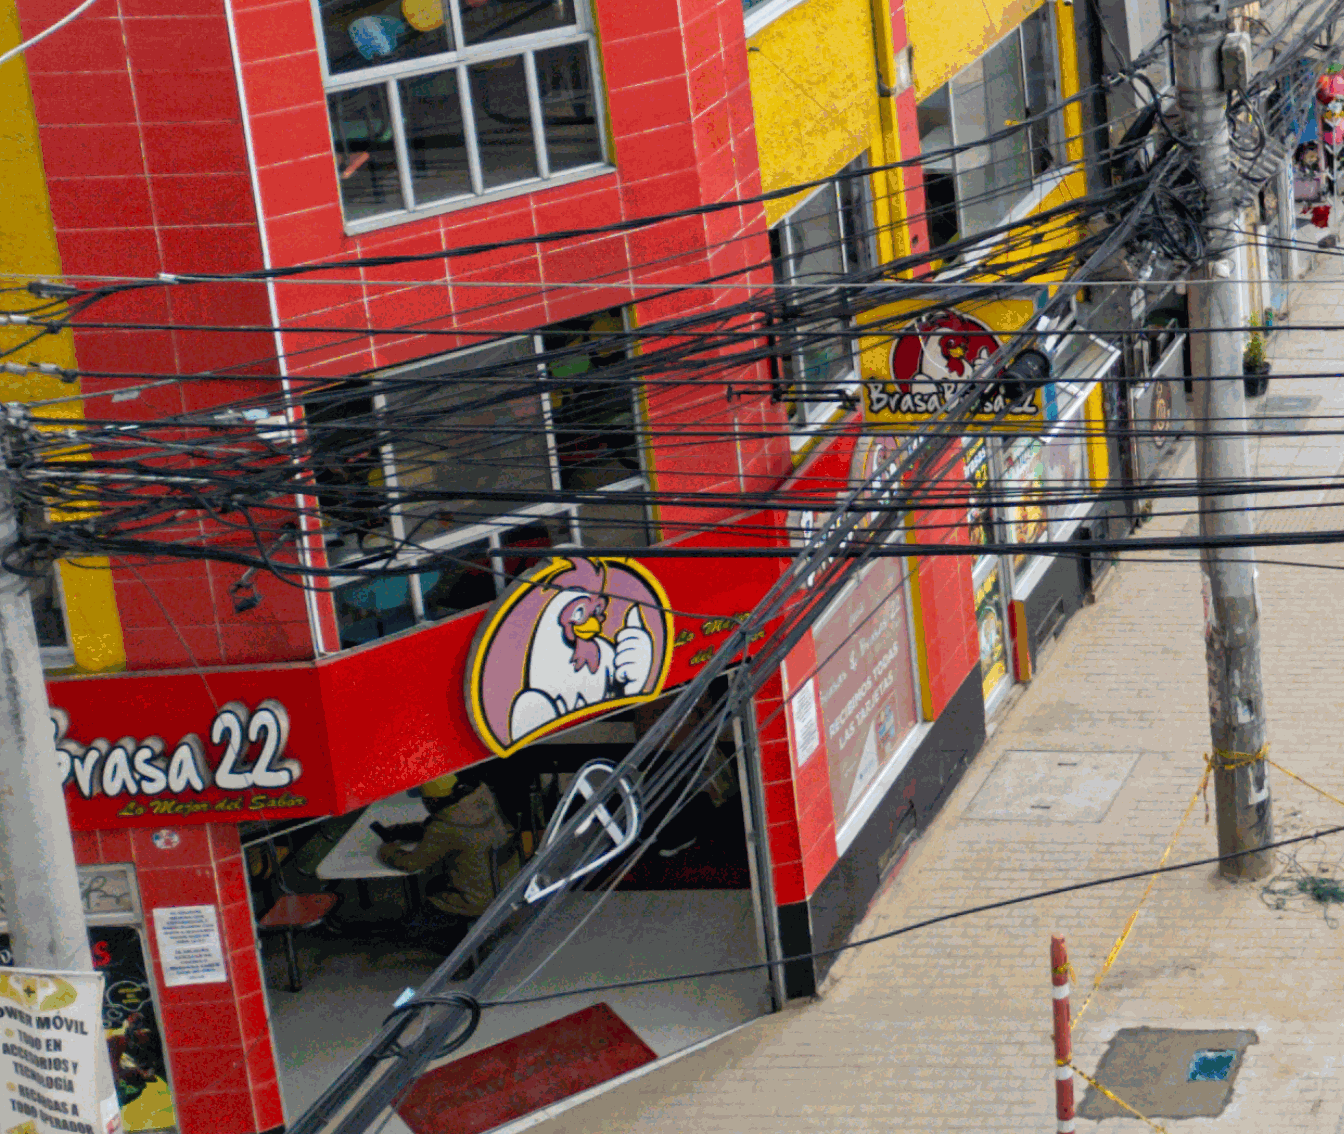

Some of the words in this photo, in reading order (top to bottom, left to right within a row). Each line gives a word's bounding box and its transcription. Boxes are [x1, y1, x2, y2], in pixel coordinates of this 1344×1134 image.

[866, 378, 941, 414] Brasa
[212, 704, 298, 791] 22
[117, 800, 146, 817] Lo
[149, 798, 211, 817] Mejor
[215, 794, 245, 812] del
[247, 793, 307, 811] Sabor
[46, 1038, 62, 1052] EN
[71, 1062, 79, 1075] Y
[71, 1104, 79, 1117] A
